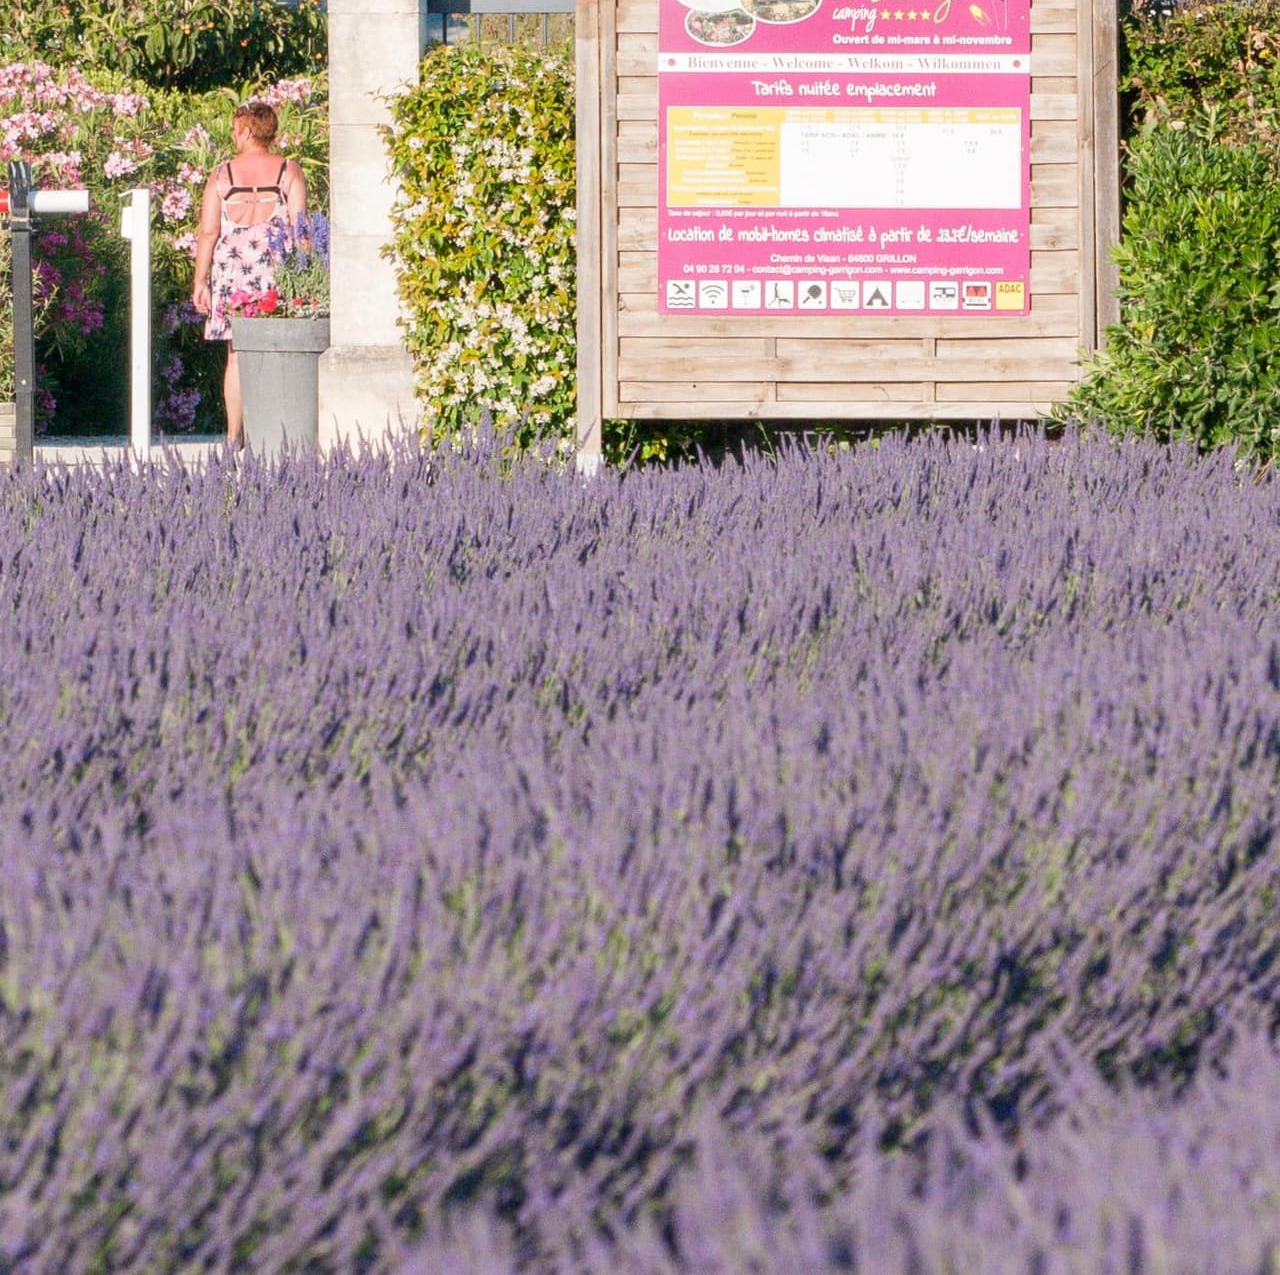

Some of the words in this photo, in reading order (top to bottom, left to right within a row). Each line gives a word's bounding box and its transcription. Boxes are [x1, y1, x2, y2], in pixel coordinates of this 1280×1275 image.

[832, 4, 878, 33] camping
[832, 33, 869, 45] Ouvert
[871, 34, 885, 45] de
[887, 34, 931, 46] mi-mars
[933, 34, 940, 46] à
[942, 35, 1013, 46] mi-novembre
[688, 56, 759, 69] Bienvenue
[772, 56, 835, 69] Welcome
[847, 57, 903, 70] Welkom
[751, 79, 794, 97] Tarifs
[798, 79, 841, 97] nuitée
[846, 81, 937, 104] emplacement
[668, 225, 715, 242] Location
[718, 224, 734, 242] de
[738, 224, 810, 242] mobil-homes
[813, 224, 864, 242] climatisé
[868, 225, 877, 243] à
[880, 226, 913, 250] partir
[917, 224, 932, 243] de
[770, 253, 803, 263] Chemin
[804, 253, 816, 263] de
[816, 253, 841, 263] Visan
[876, 254, 917, 263] GRILLON
[683, 264, 694, 273] 04
[695, 264, 707, 273] 90
[708, 264, 721, 273] 28
[722, 264, 733, 273] 72
[752, 265, 883, 277] contact@camping-garrigon.com
[890, 266, 1004, 277] www.camping-garrigon.com
[998, 284, 1022, 294] ADAC
